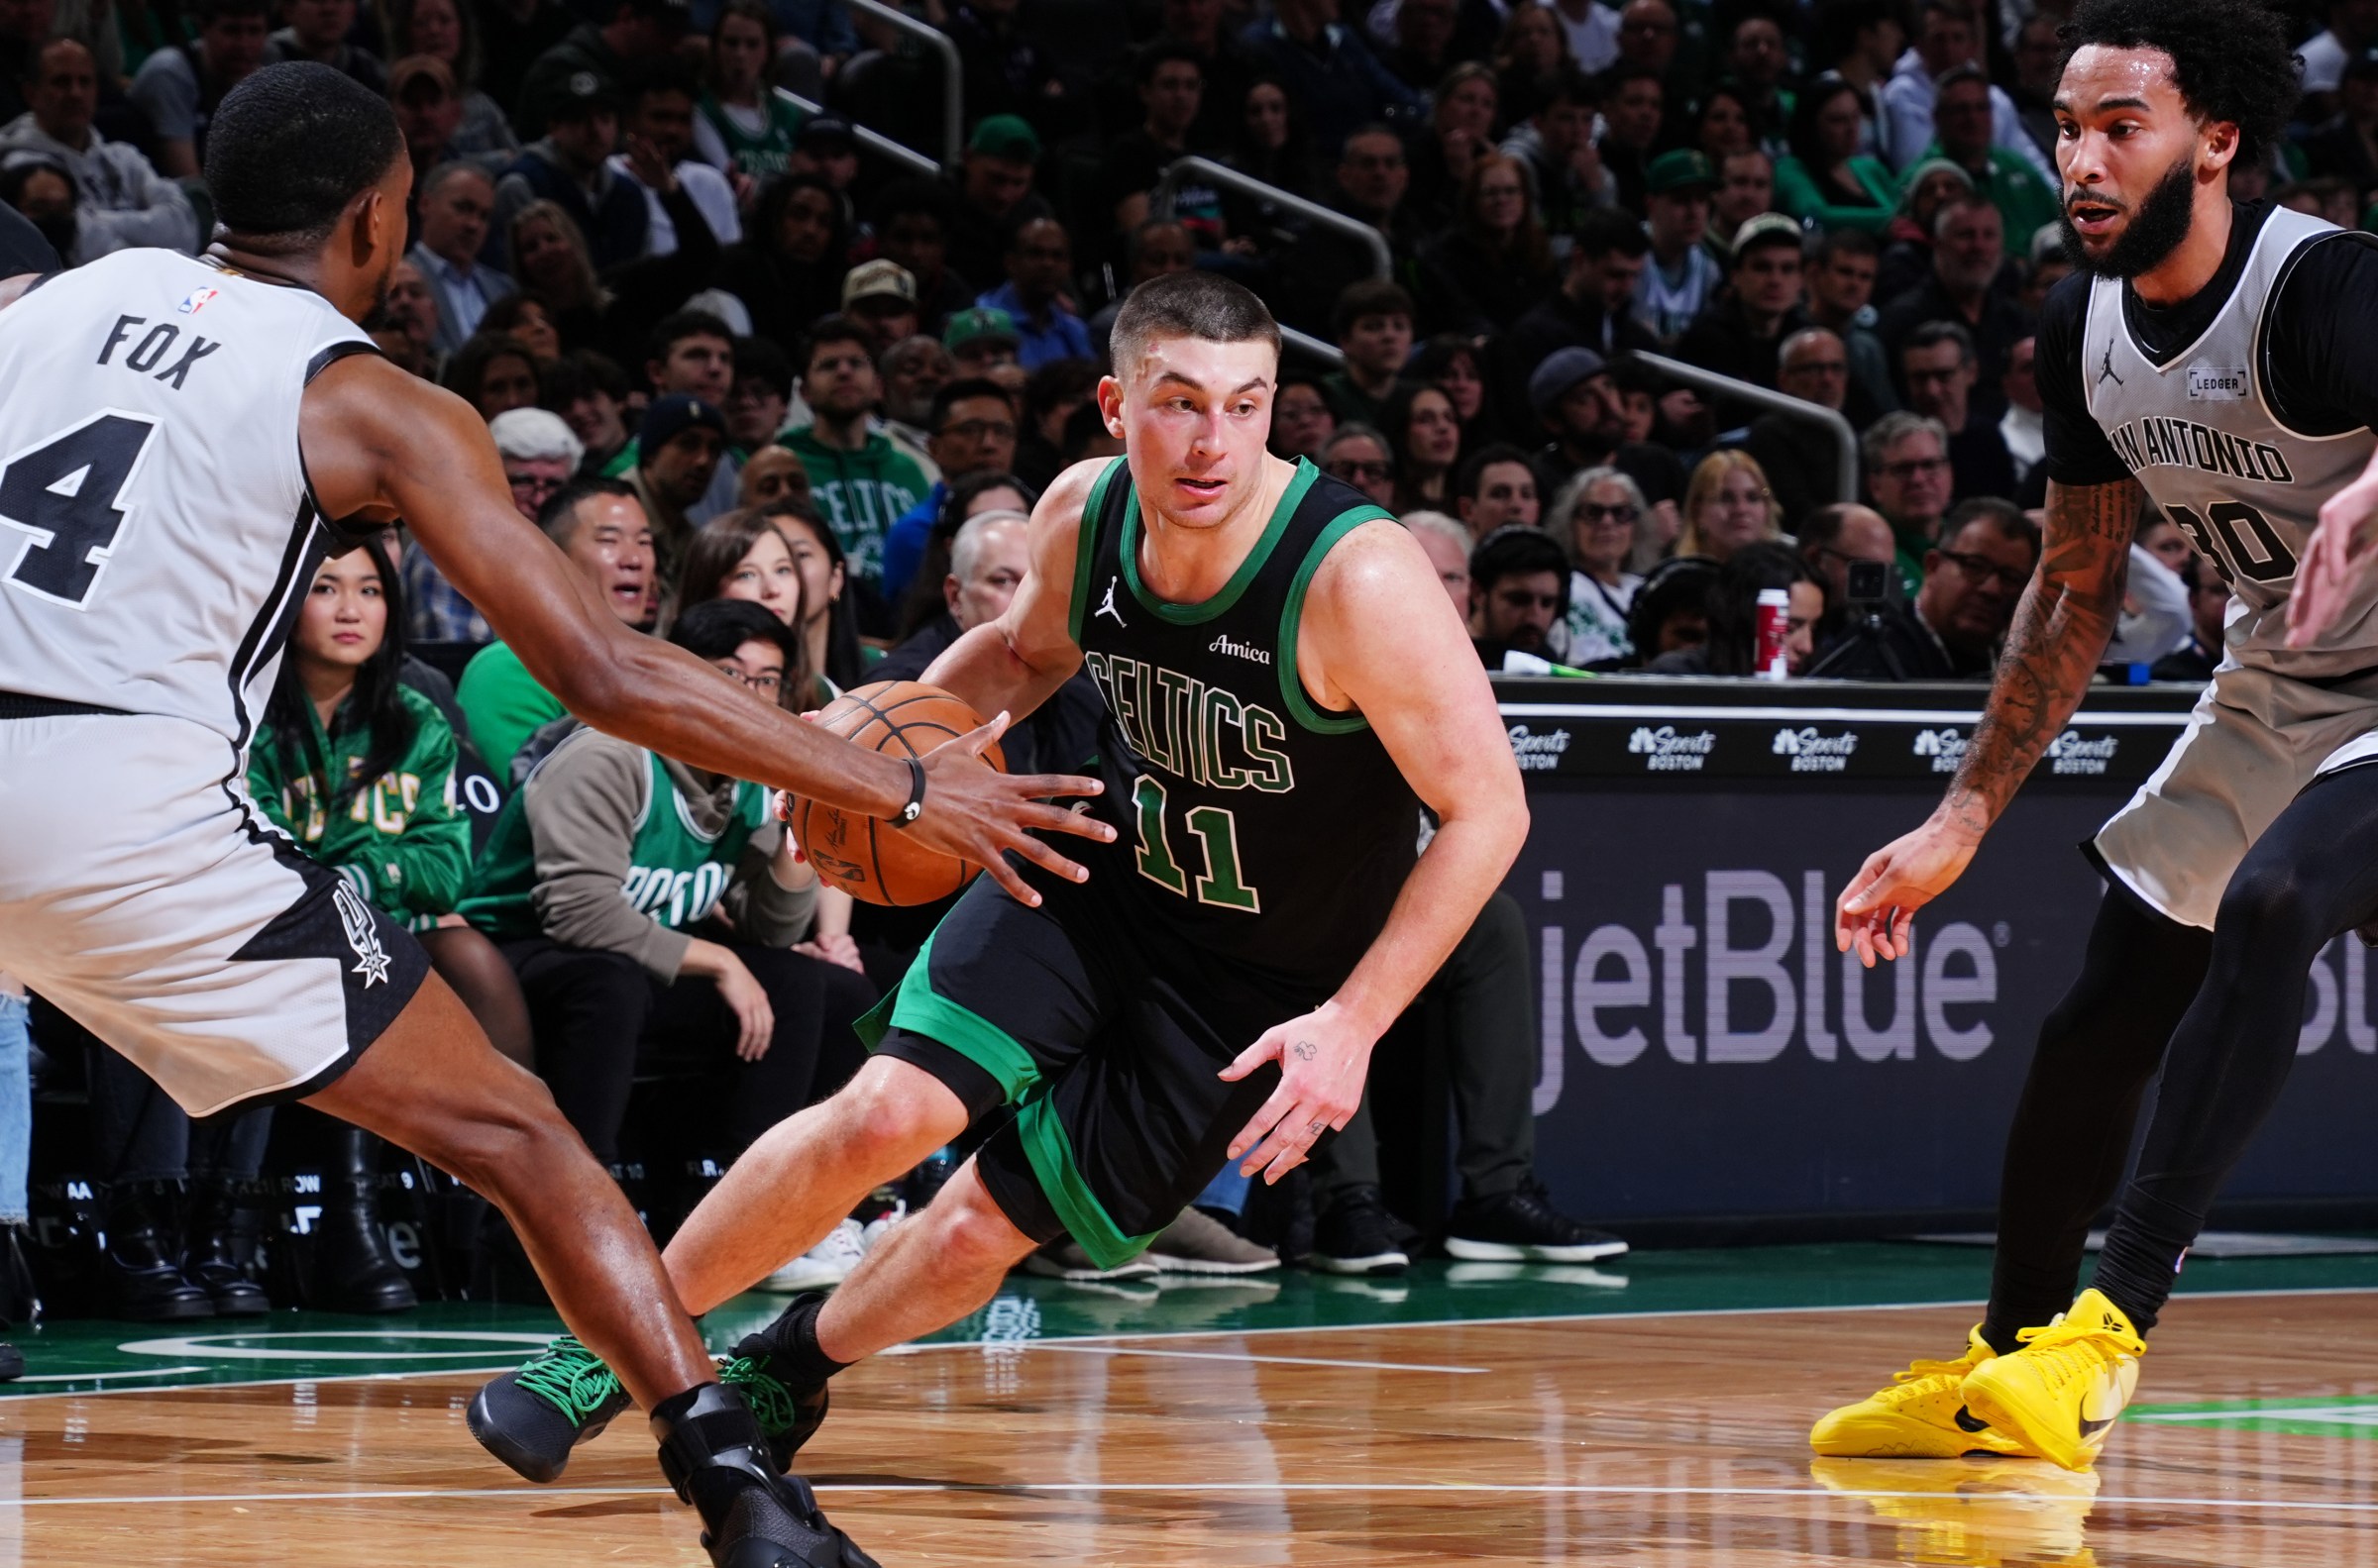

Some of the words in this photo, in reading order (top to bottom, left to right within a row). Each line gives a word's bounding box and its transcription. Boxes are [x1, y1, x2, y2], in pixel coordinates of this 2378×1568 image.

[97, 314, 222, 391] FOX
[2196, 377, 2239, 390] LEDGER
[2109, 420, 2148, 475] AN
[2141, 415, 2296, 484] ANTONIO
[0, 406, 164, 612] 4
[2162, 499, 2300, 588] 30
[1209, 634, 1271, 666] Amica
[1085, 651, 1296, 794] CELTICS
[1509, 725, 1571, 755] Sports
[1654, 726, 1717, 755] Sports
[1797, 727, 1860, 756] Sports
[2061, 731, 2120, 760] Sports
[1647, 754, 1704, 772] BOSTON
[1791, 756, 1847, 773] BOSTON
[2053, 759, 2108, 775] BOSTON
[1132, 773, 1262, 914] 11
[1532, 870, 1999, 1116] jetBlue
